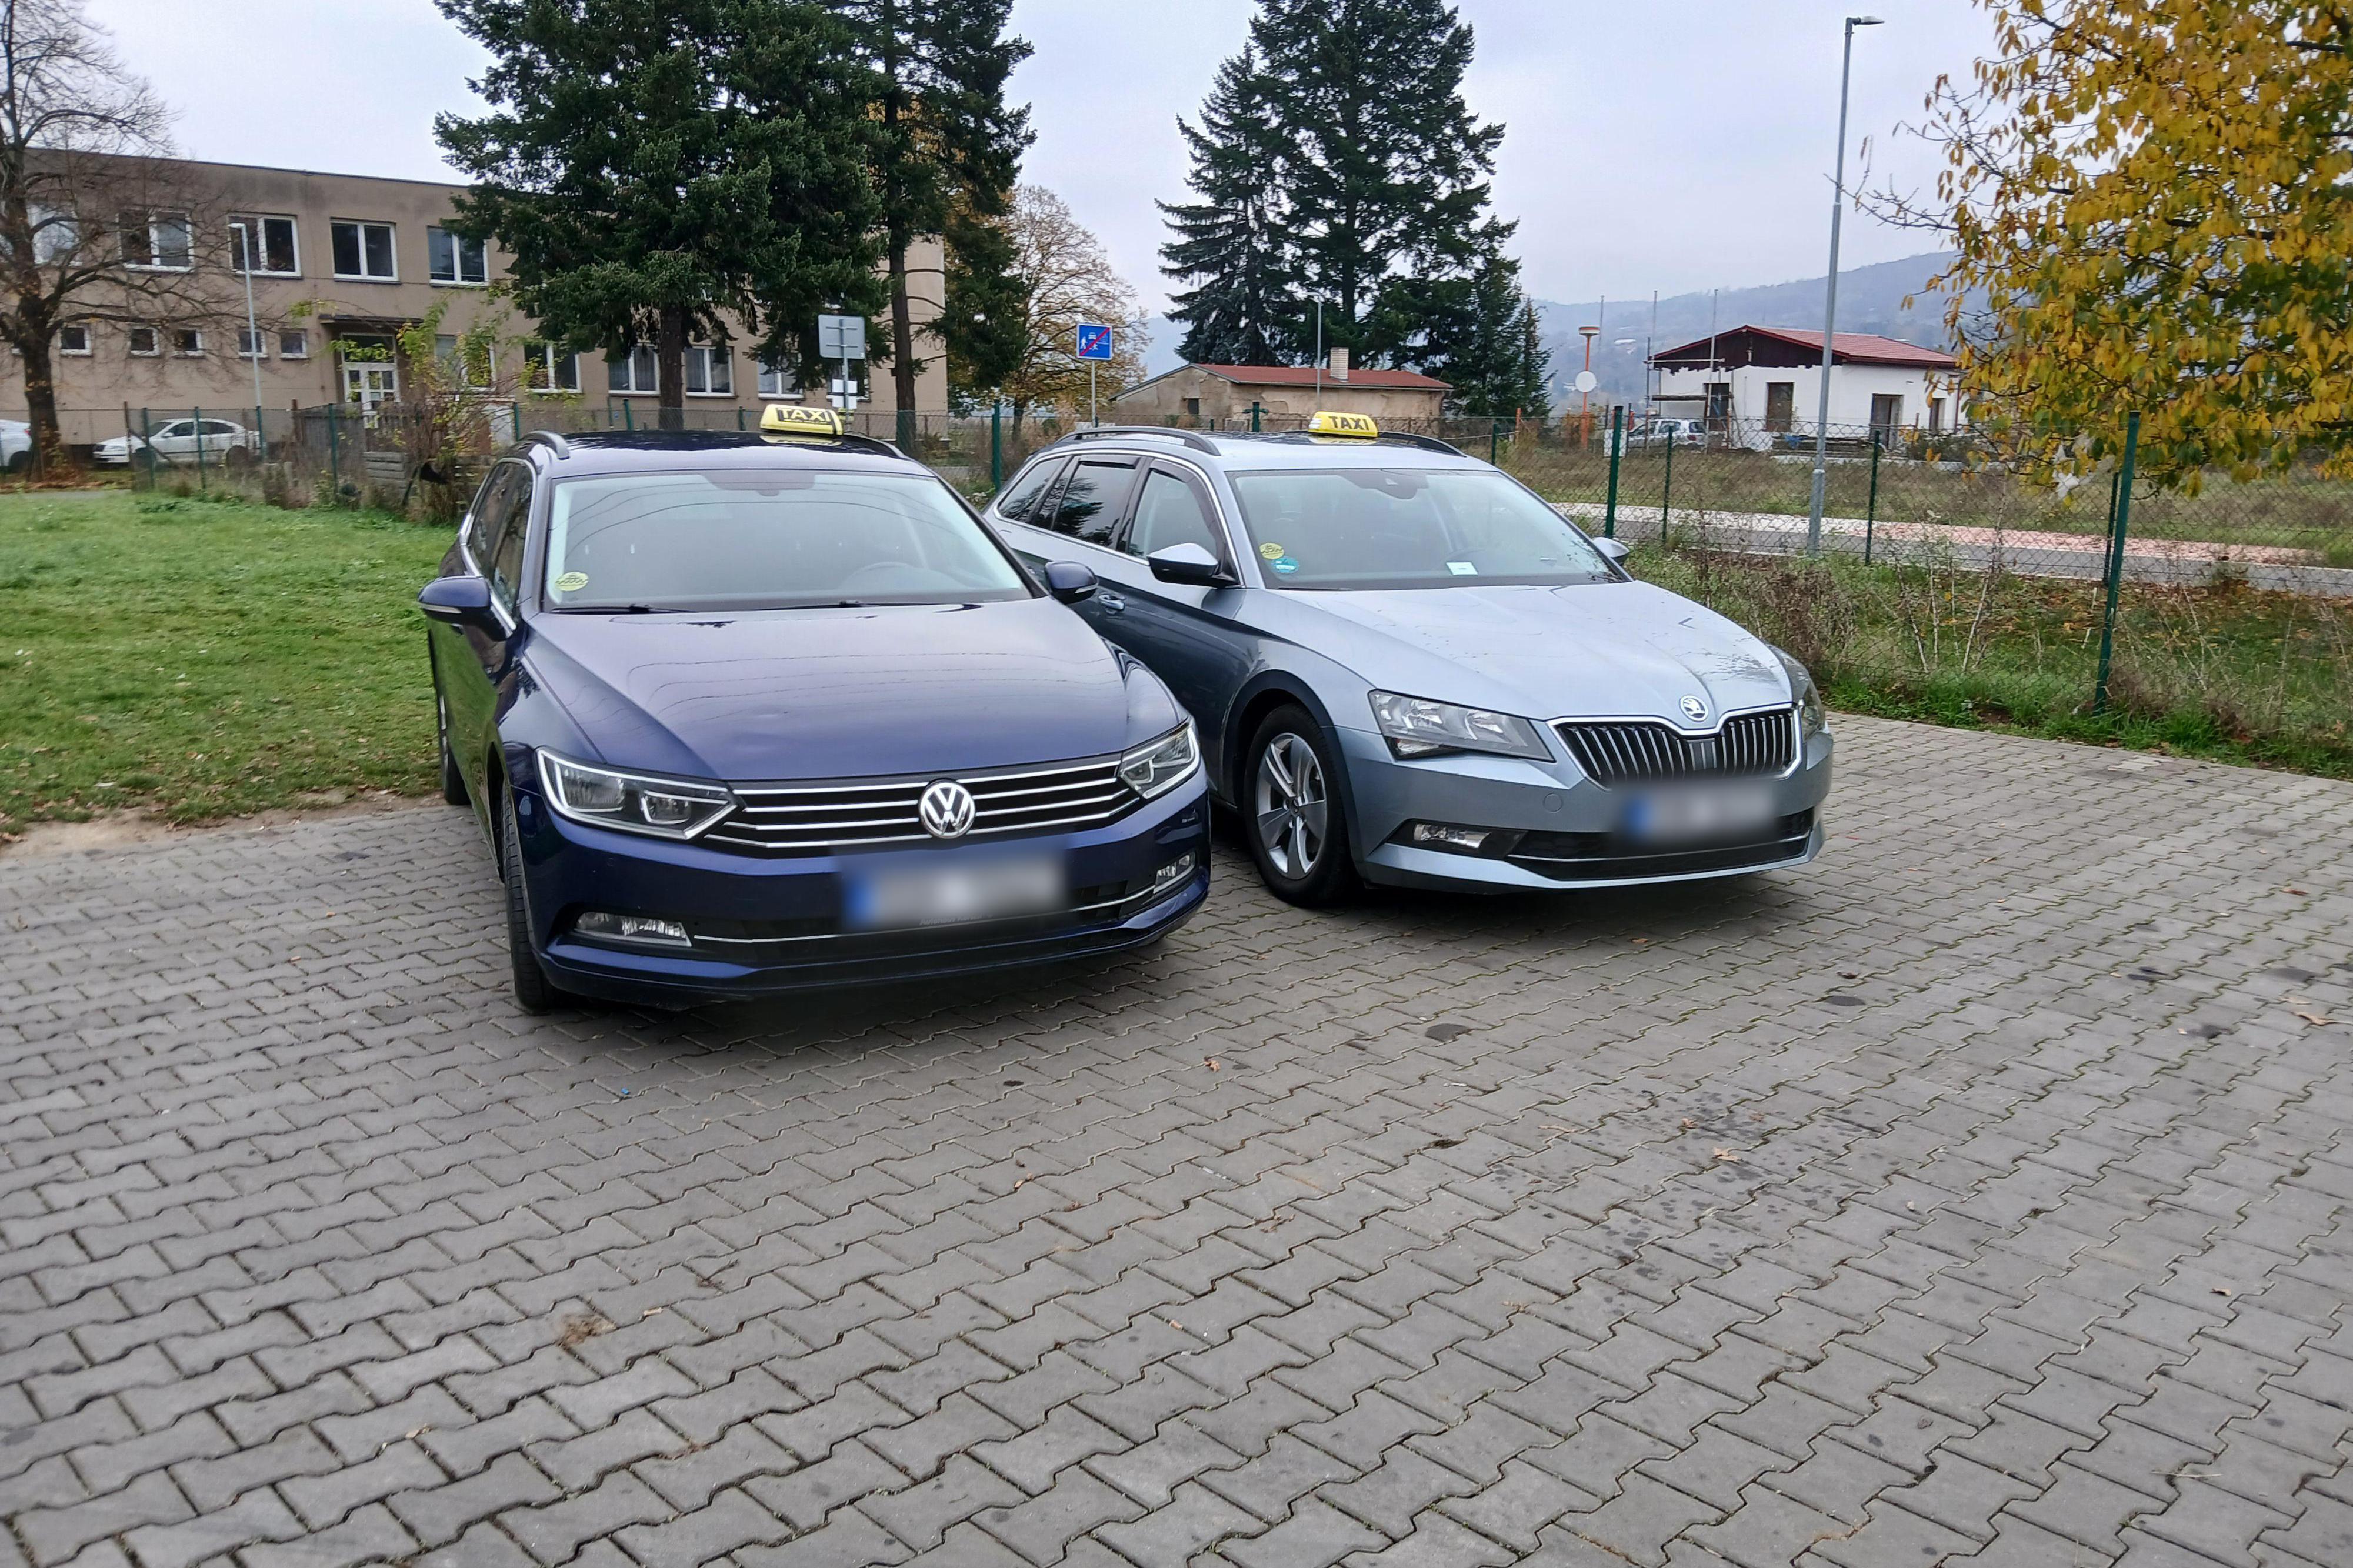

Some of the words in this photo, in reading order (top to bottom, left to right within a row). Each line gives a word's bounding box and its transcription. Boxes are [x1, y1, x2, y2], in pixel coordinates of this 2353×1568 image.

[778, 408, 832, 422] TAXI
[1328, 416, 1369, 430] TAXI
[922, 785, 974, 835] VW
